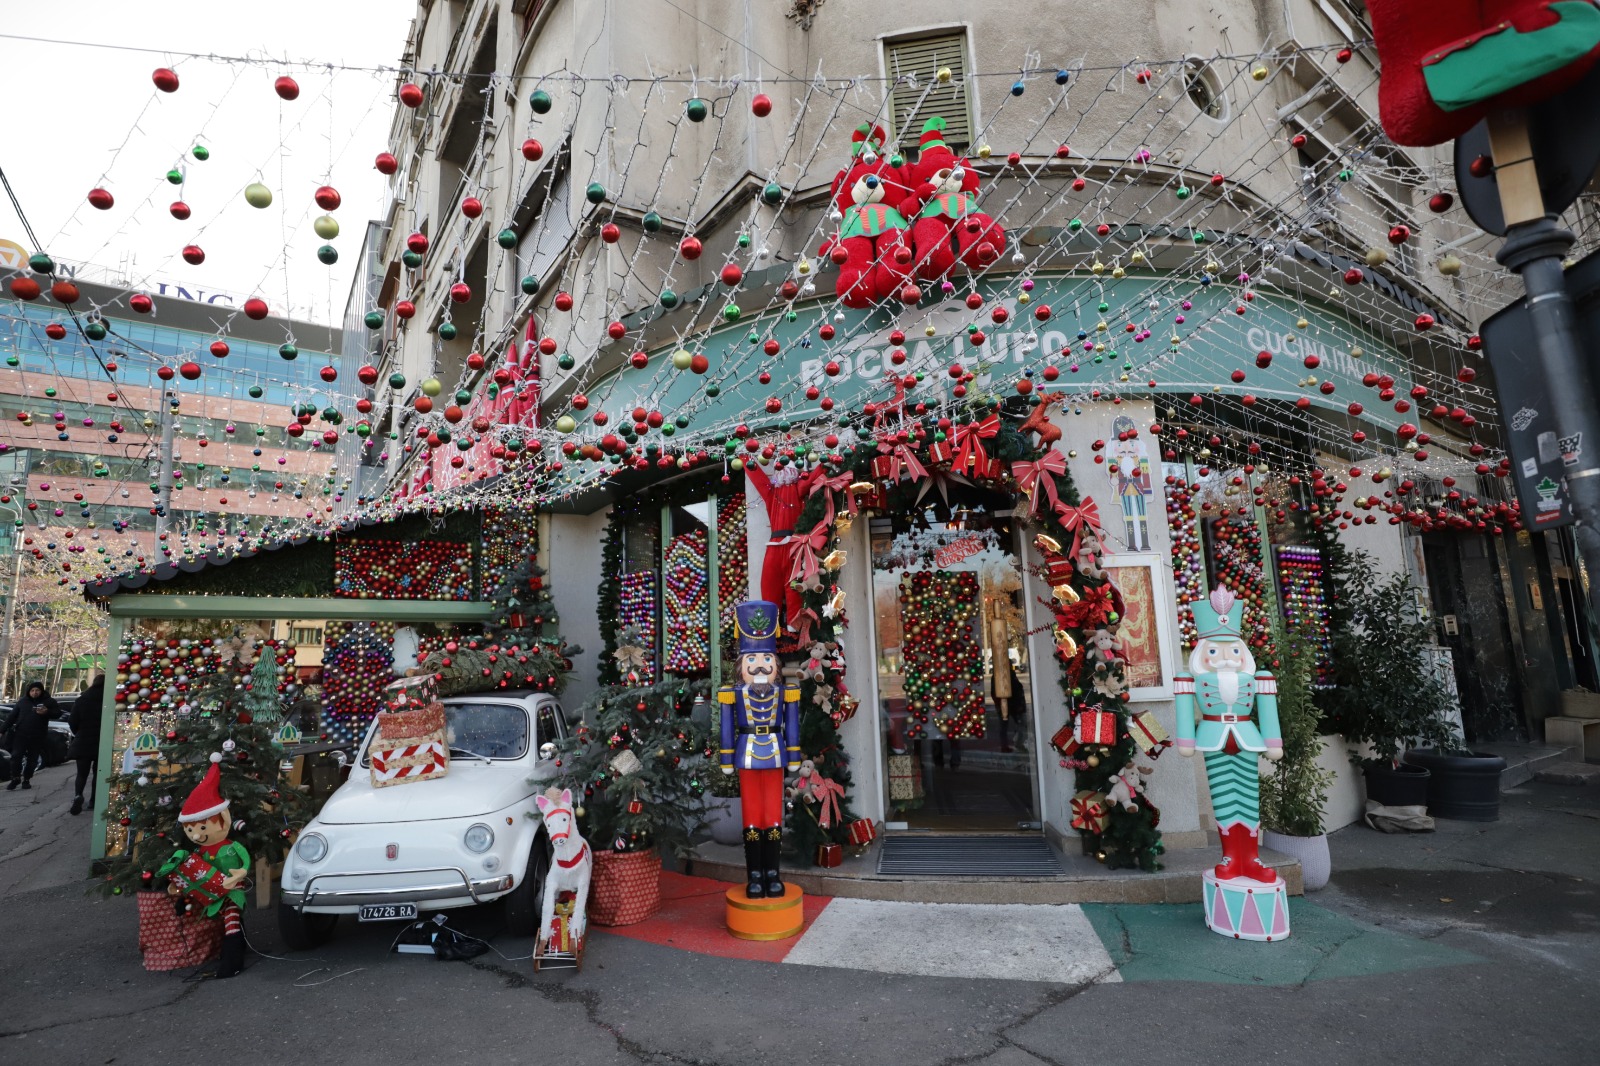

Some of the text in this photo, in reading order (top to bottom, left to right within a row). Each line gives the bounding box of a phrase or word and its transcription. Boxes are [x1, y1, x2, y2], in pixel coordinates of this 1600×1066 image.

[800, 331, 1068, 391] BOCCA LUPO
[1247, 327, 1331, 369] CUCINA
[363, 906, 412, 918] 174726 RA
